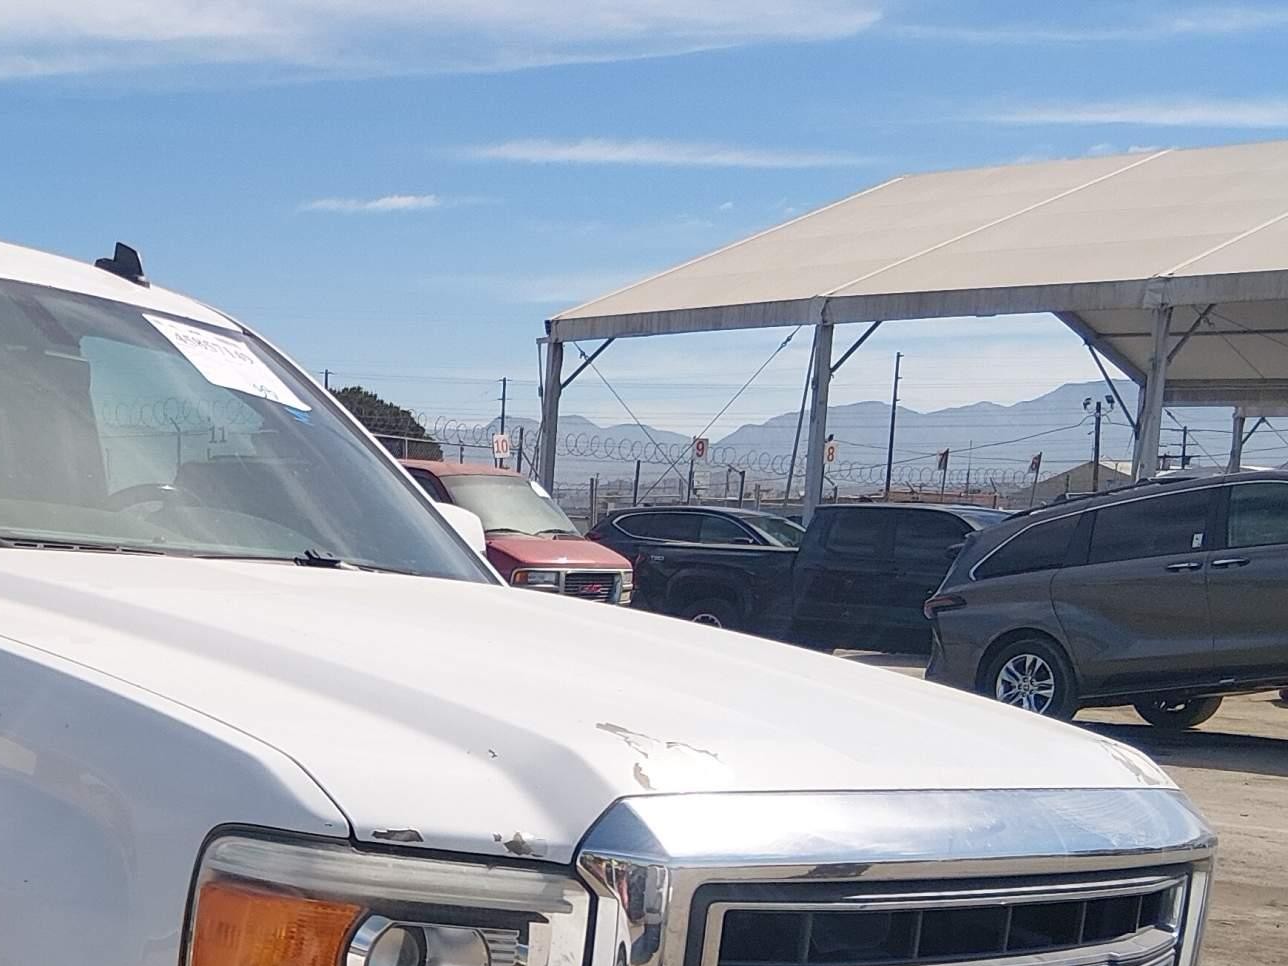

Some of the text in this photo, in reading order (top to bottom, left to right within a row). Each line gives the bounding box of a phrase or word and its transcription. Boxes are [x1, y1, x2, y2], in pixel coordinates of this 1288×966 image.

[494, 439, 508, 453] 10
[696, 440, 705, 457] 9
[827, 446, 835, 462] 8
